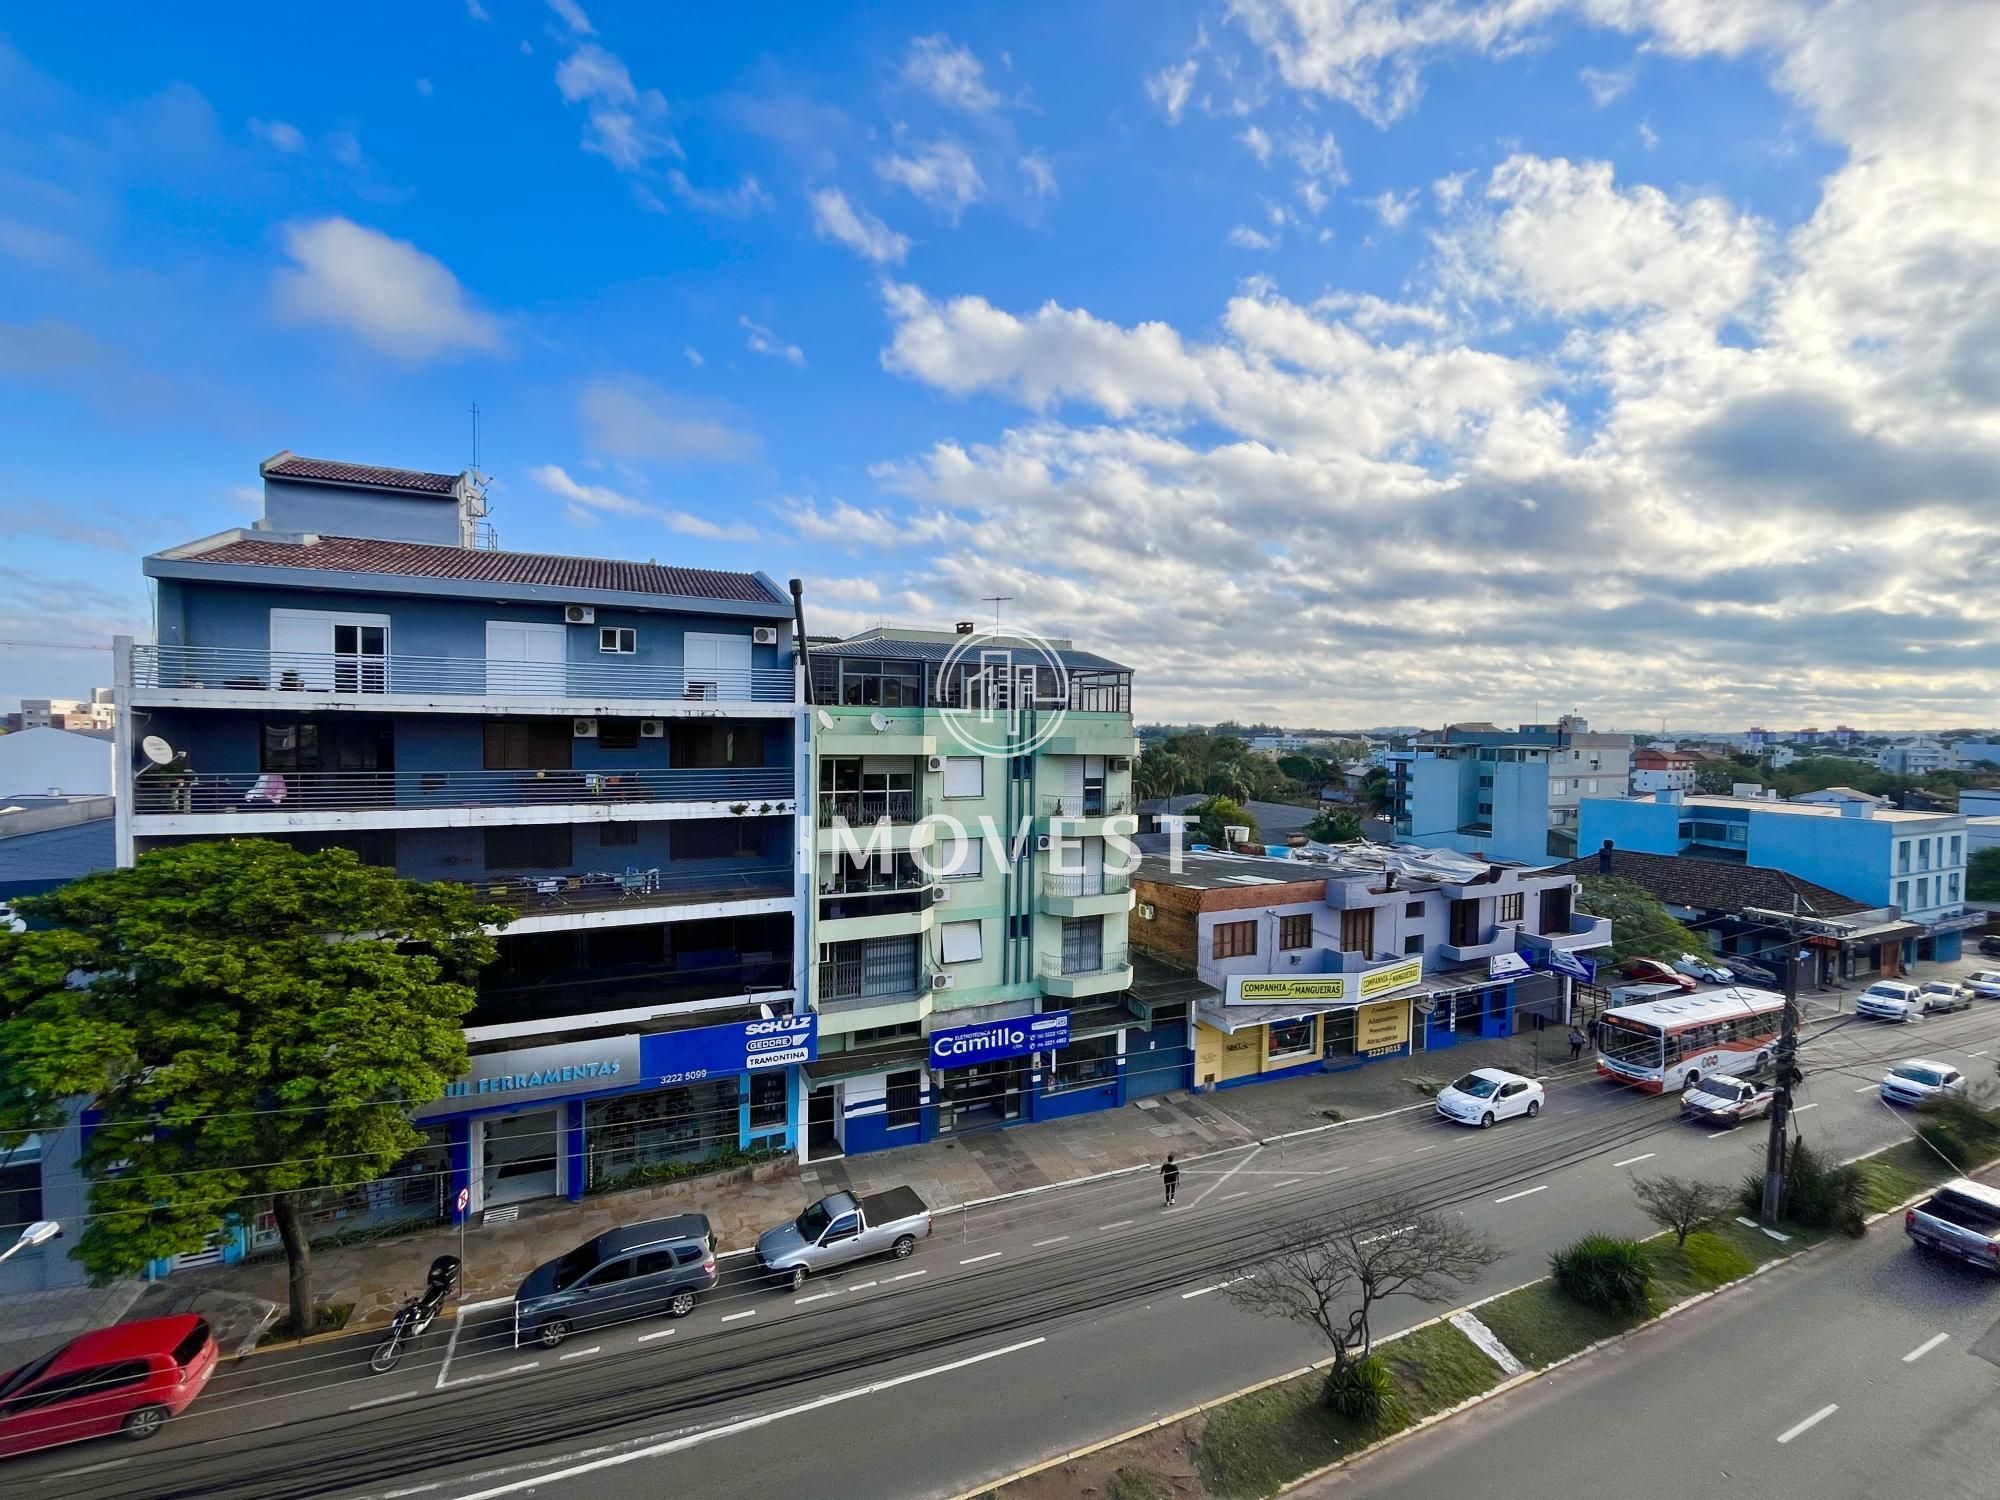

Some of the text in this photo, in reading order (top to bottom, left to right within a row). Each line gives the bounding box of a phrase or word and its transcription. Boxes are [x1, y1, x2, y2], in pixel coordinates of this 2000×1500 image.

[1364, 974, 1388, 988] COMPANHIA
[1244, 983, 1287, 992] COMPANHIA
[1294, 985, 1340, 995] MANGUEIRAS
[745, 1016, 812, 1035] SCHULZ
[749, 1038, 789, 1050] GEDORE
[749, 1051, 806, 1066] TRAMONTINA
[478, 1058, 621, 1096] FERRAMENTAS
[660, 1069, 707, 1085] 3222 5099
